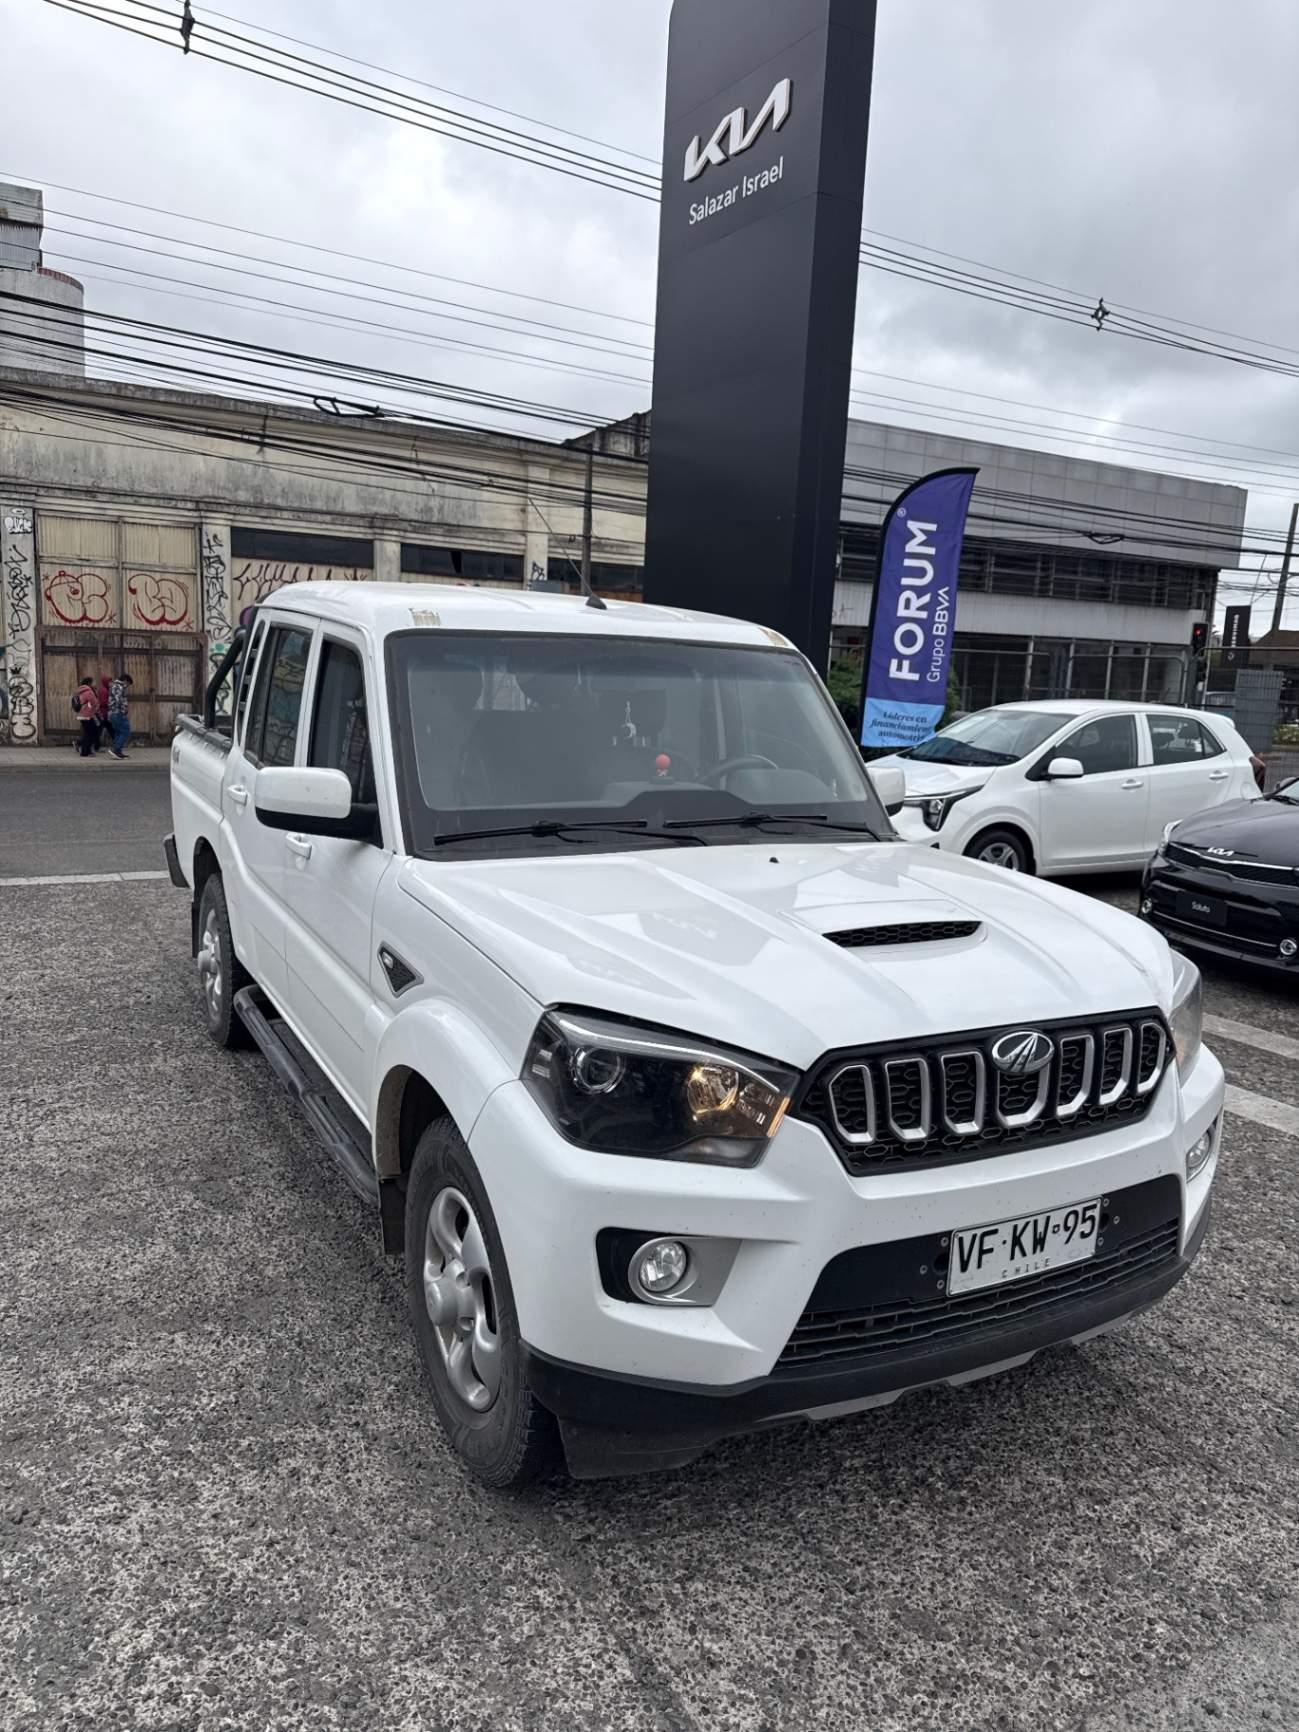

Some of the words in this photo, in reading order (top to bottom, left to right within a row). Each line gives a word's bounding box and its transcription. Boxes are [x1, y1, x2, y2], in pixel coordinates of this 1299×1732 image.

[689, 185, 739, 225] Salazar
[742, 156, 784, 198] Israel
[889, 520, 938, 681] FORUM
[932, 586, 950, 637] BBVA
[926, 638, 945, 683] Grupo
[1001, 1257, 1051, 1279] CHILE
